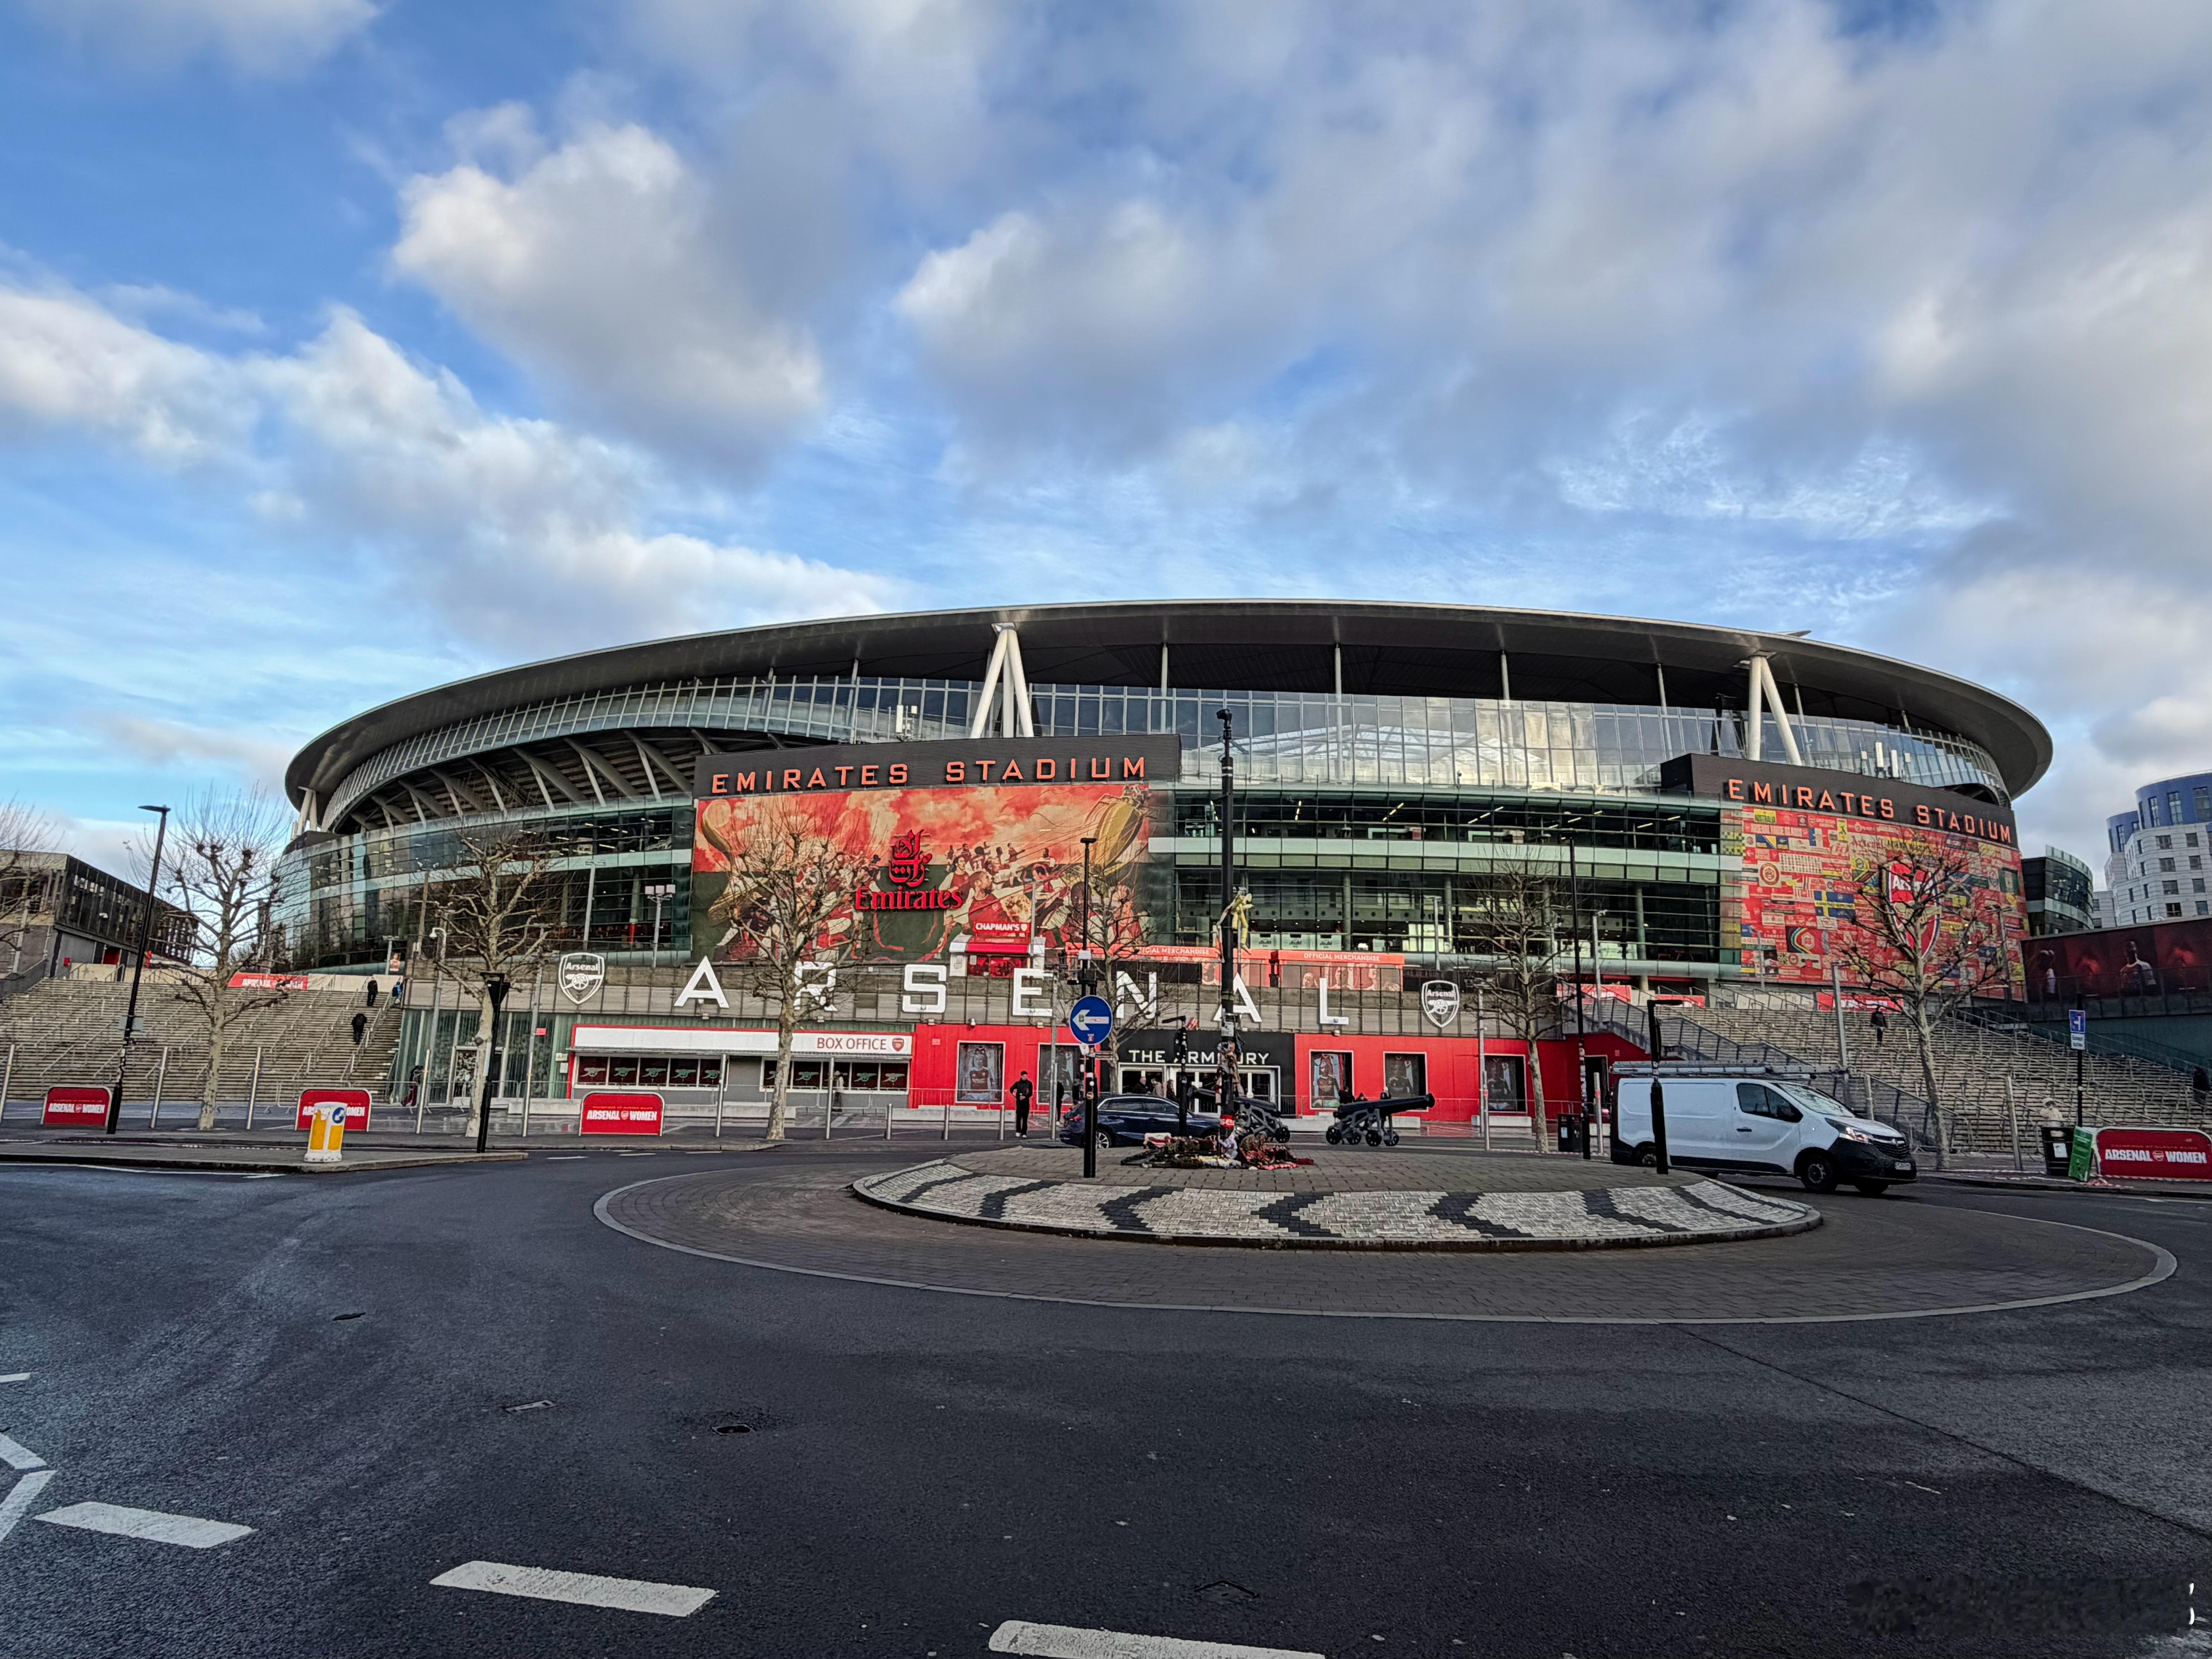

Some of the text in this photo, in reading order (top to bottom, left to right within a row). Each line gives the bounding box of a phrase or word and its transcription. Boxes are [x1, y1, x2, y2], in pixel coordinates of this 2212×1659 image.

[712, 757, 1144, 793] EMIRATES STADIUM
[1728, 778, 2011, 843] EMIRATES STADIUM
[854, 886, 963, 910] Emirates
[975, 922, 1020, 931] CHAPMAN'S
[565, 962, 598, 971] Arsenal
[674, 955, 1349, 1025] ARSENAL
[1427, 989, 1455, 997] Arsenal
[817, 1037, 886, 1050] BOX OFFICE
[1128, 1050, 1165, 1063] THE
[587, 1110, 658, 1121] ARSENAL WOMEN
[2105, 1149, 2207, 1164] ARSENAL WOMEN
